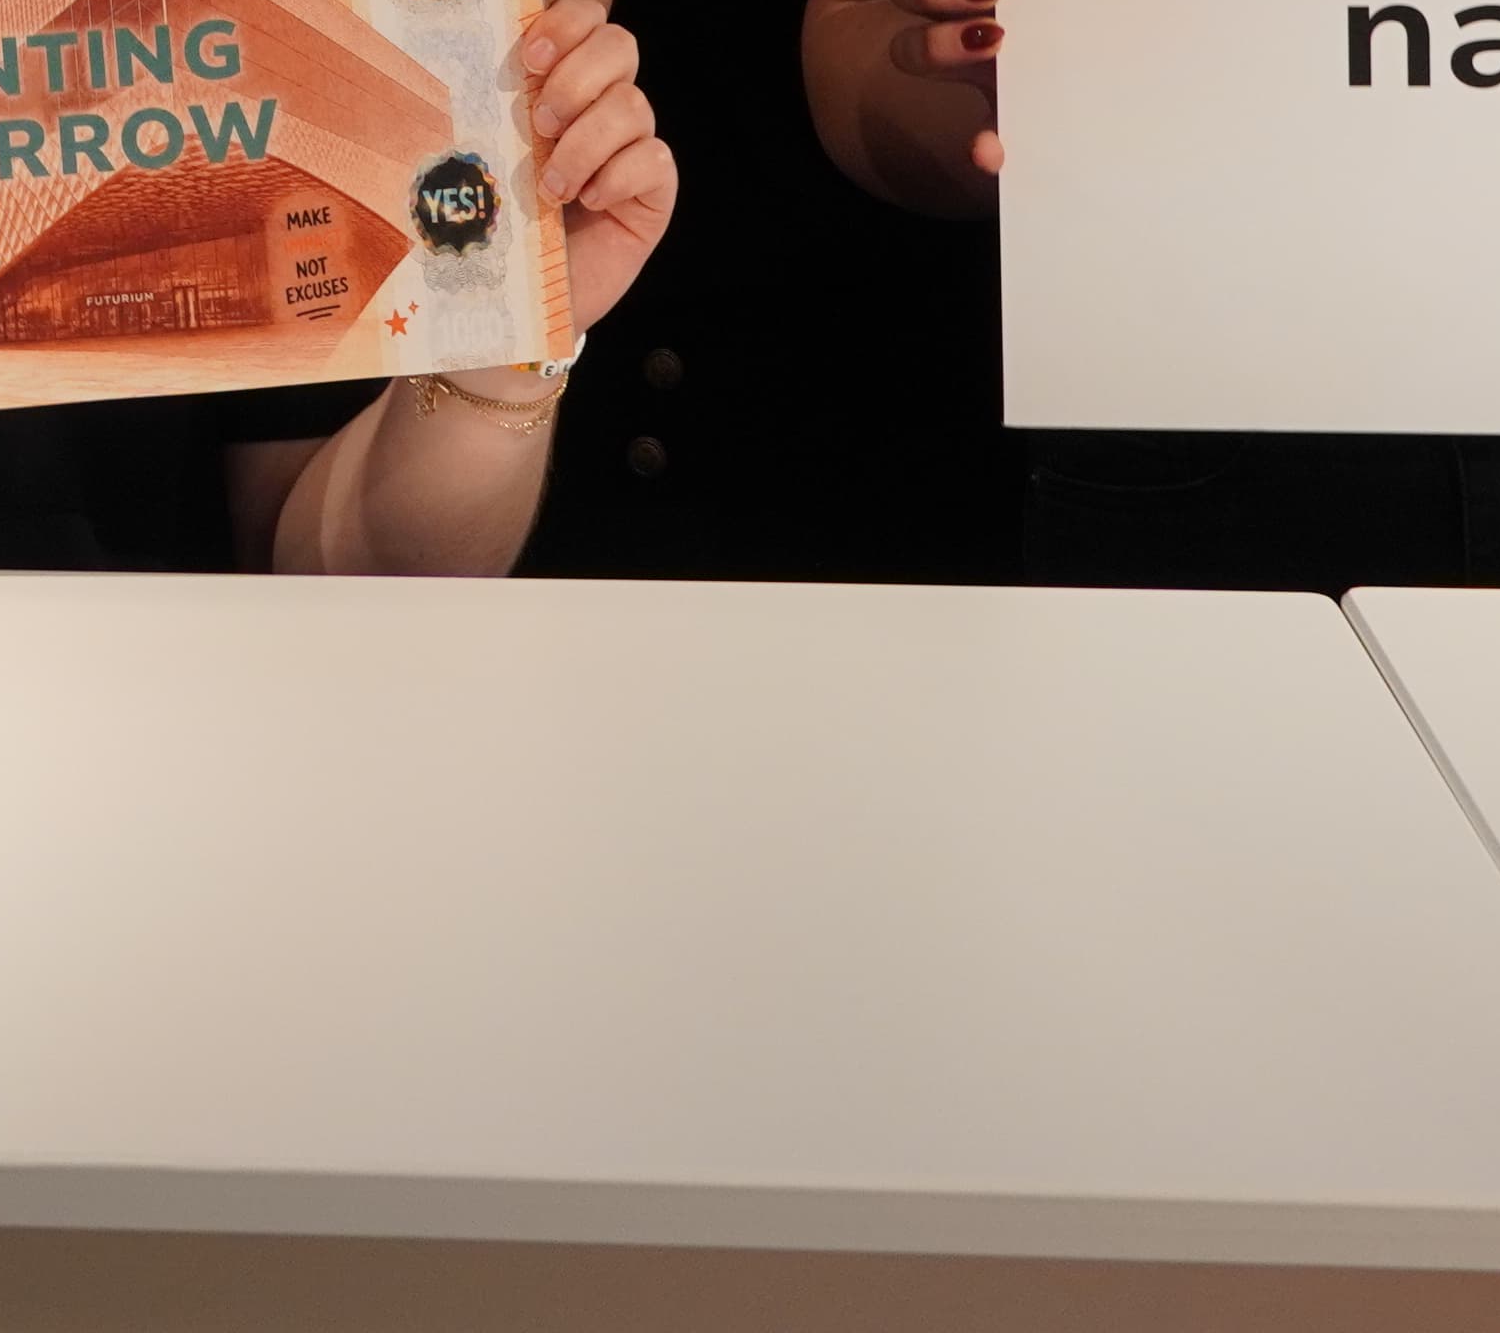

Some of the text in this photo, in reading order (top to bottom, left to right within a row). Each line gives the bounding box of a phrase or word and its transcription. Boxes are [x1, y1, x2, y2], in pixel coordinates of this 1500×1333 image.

[422, 185, 487, 224] YES!
[286, 206, 332, 231] MAKE
[296, 256, 328, 279] NOT
[285, 276, 349, 305] EXCUSES
